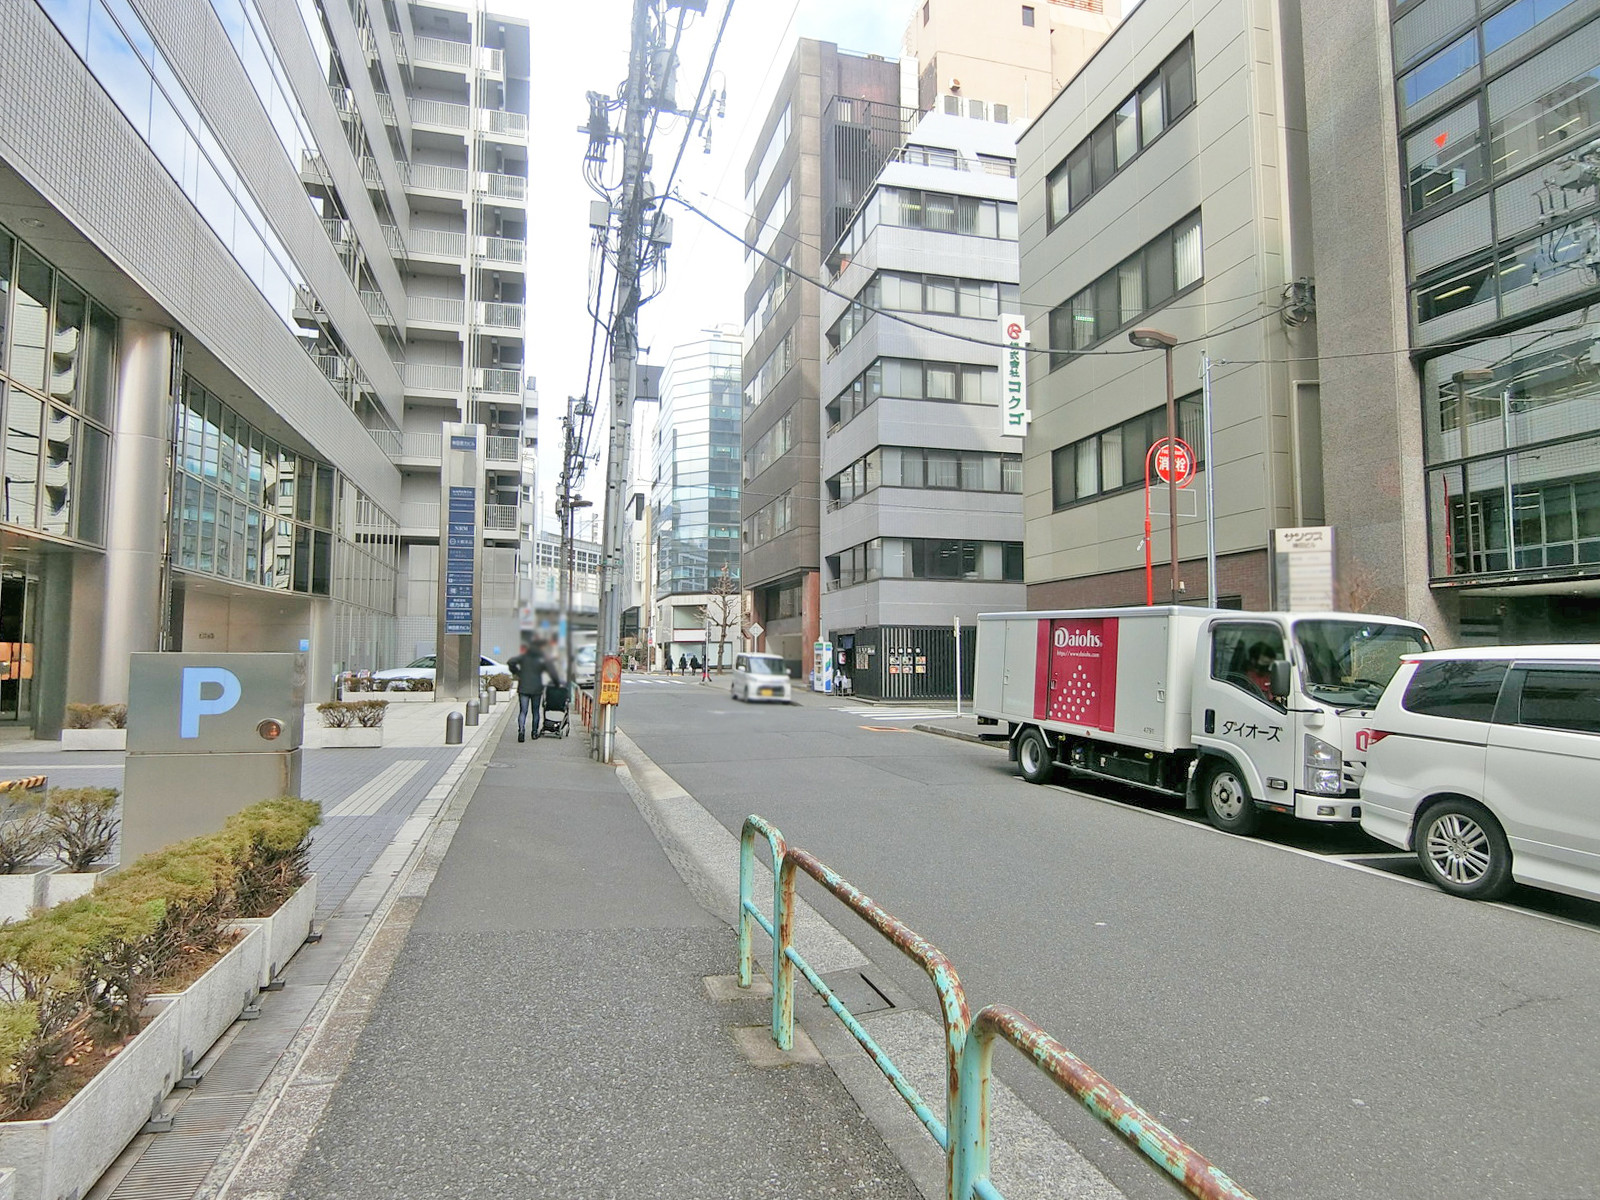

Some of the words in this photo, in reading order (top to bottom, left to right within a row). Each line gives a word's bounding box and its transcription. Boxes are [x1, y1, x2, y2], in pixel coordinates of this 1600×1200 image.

[1159, 455, 1186, 472] 消栓
[1054, 627, 1100, 648] Daiohs
[180, 667, 242, 739] P
[1222, 720, 1284, 742] ダイオーズ
